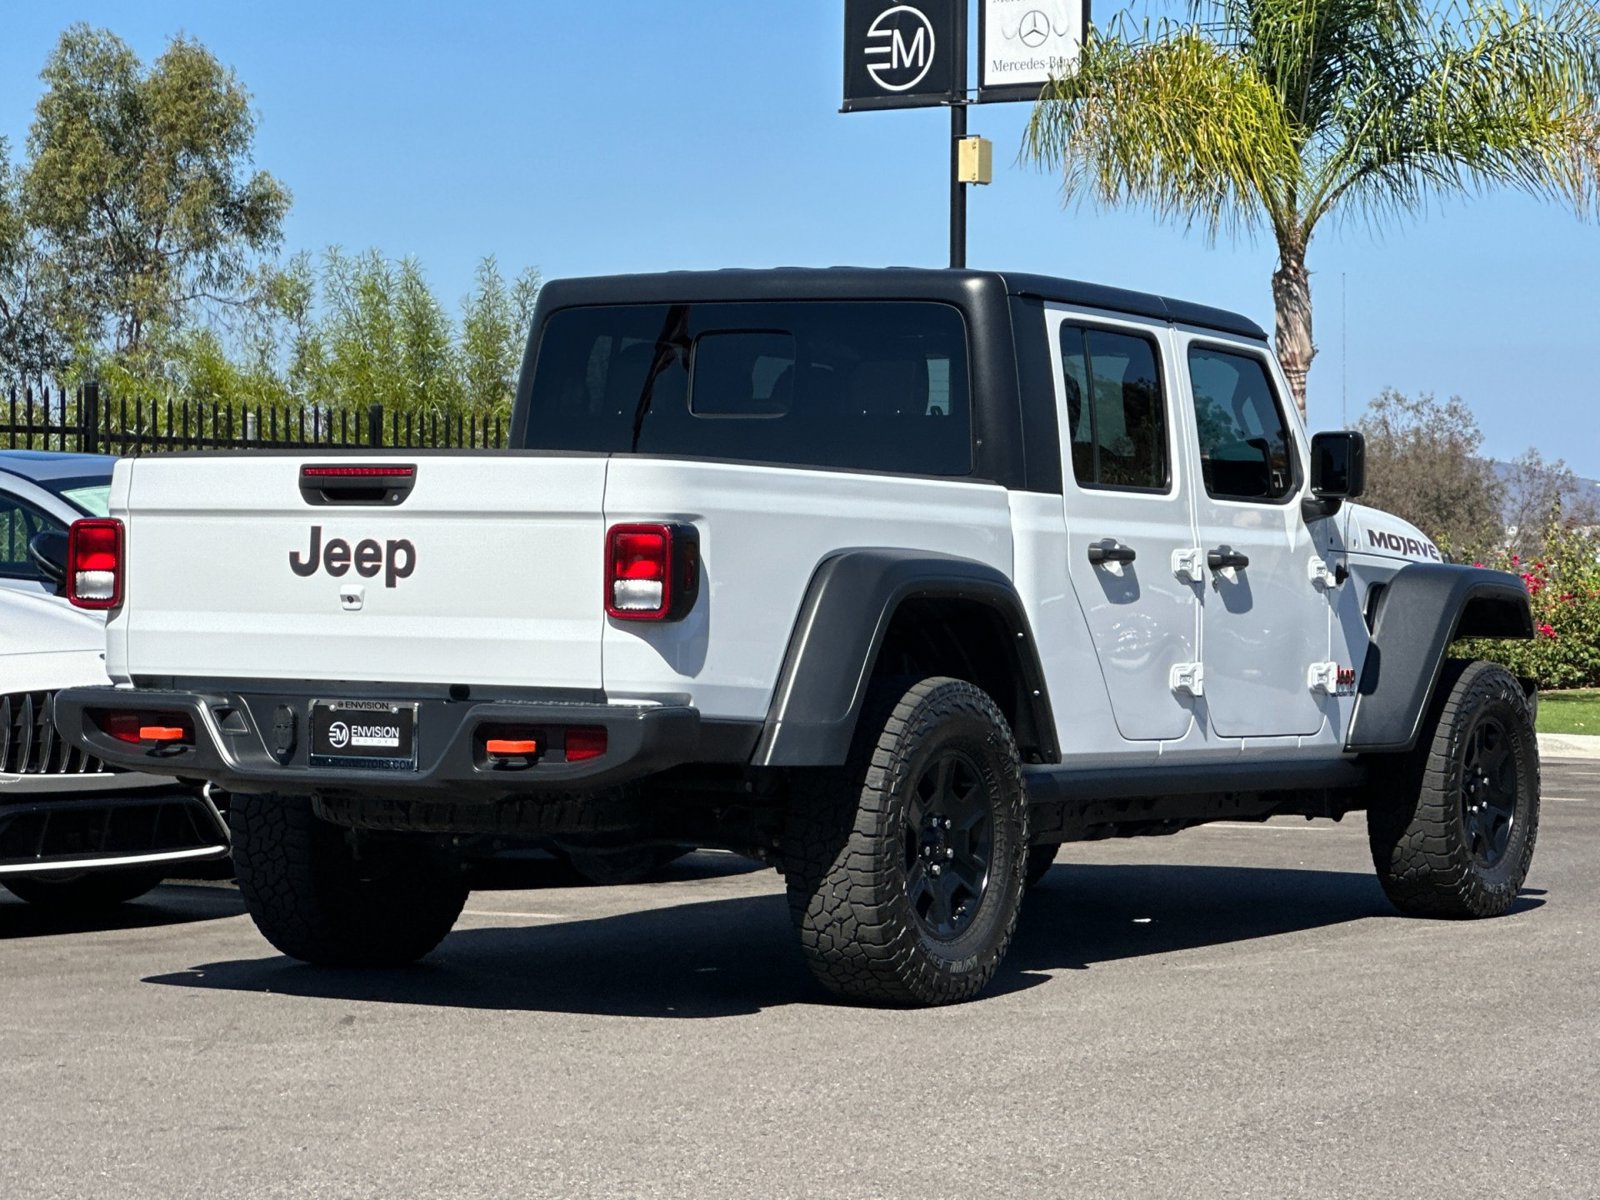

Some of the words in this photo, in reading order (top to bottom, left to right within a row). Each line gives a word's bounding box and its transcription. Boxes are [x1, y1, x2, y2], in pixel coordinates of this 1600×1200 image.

[992, 56, 1080, 73] Mercedes-Bn
[1367, 529, 1440, 561] MOJAVE
[289, 526, 416, 588] Jeep
[345, 701, 389, 710] ENVISION
[351, 725, 399, 738] ENVISION
